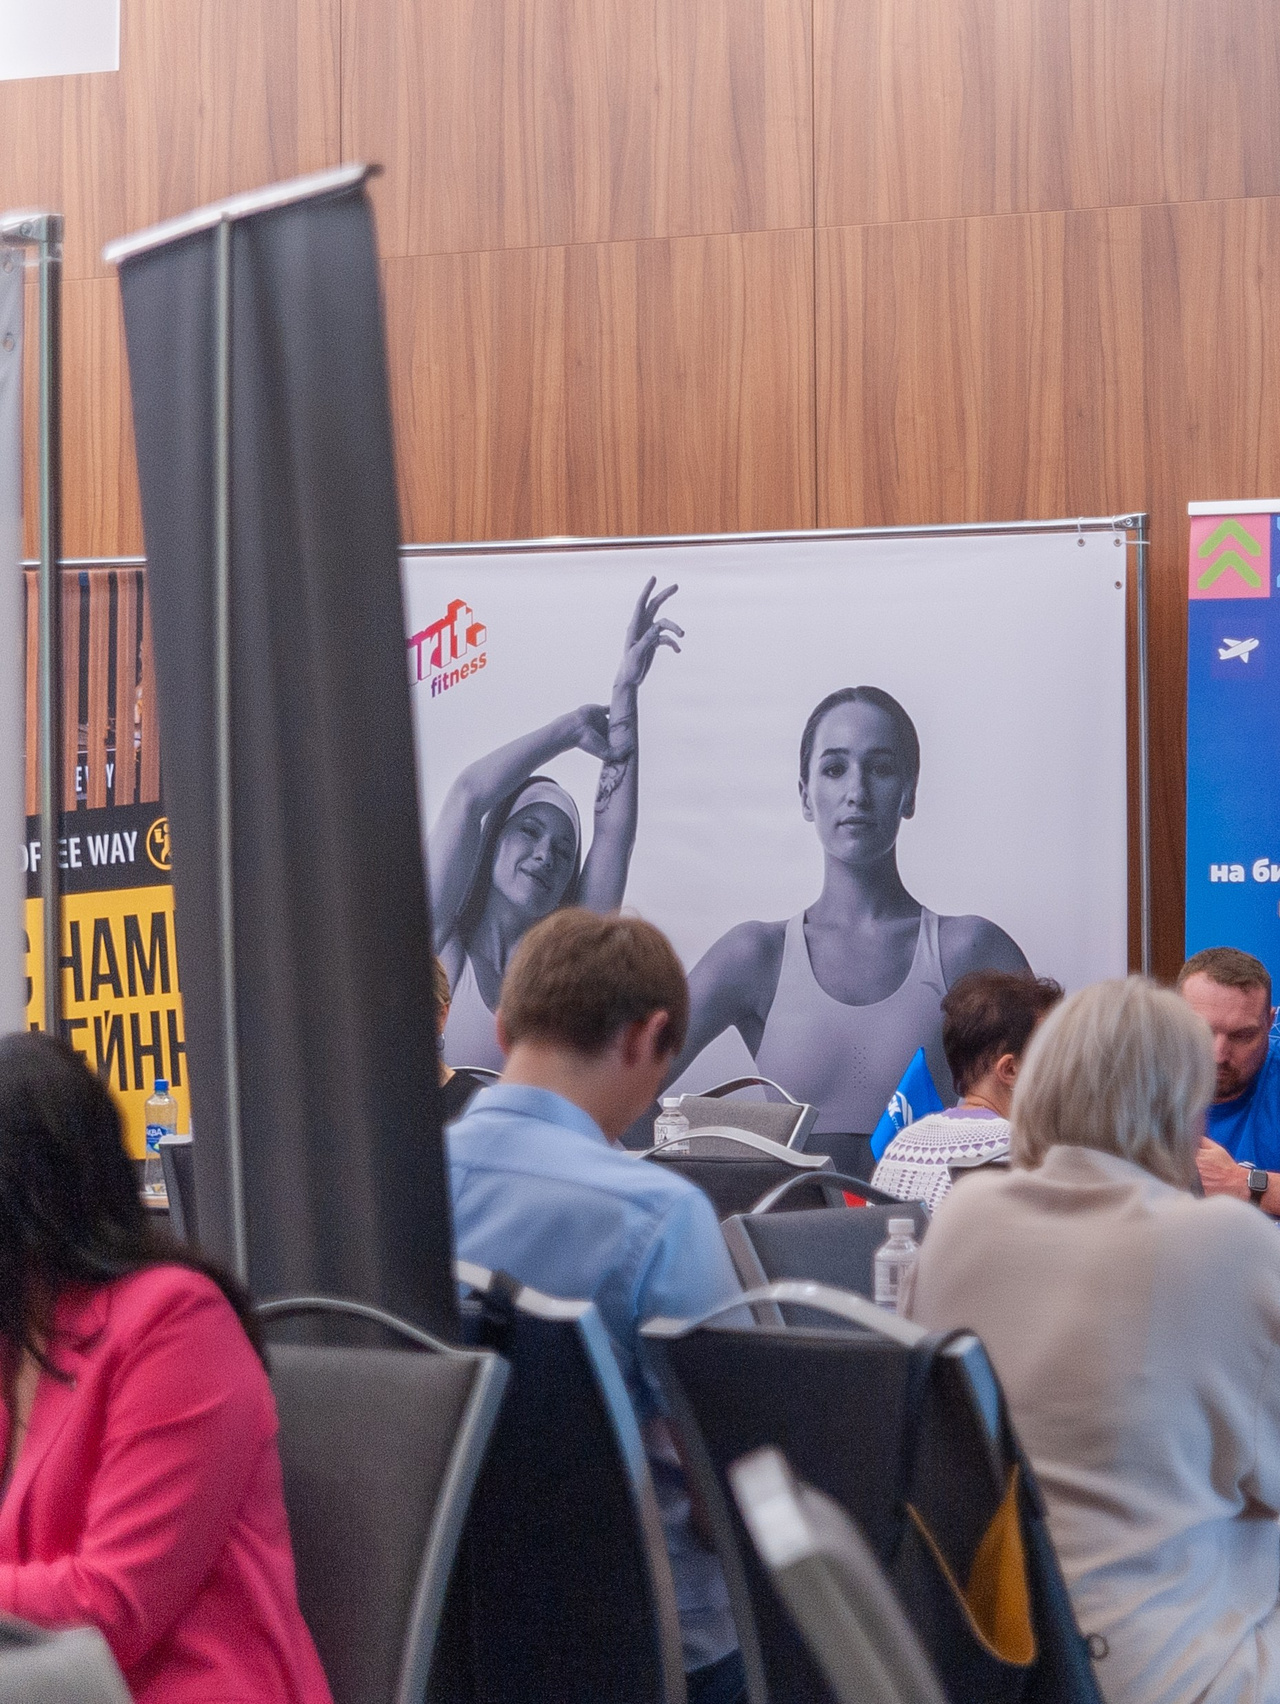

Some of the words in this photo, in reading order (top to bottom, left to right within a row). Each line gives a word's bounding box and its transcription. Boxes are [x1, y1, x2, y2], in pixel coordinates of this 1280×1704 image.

[431, 652, 487, 698] fitness
[87, 830, 137, 866] WAY
[1210, 864, 1245, 882] на
[58, 910, 181, 1003] НАМ
